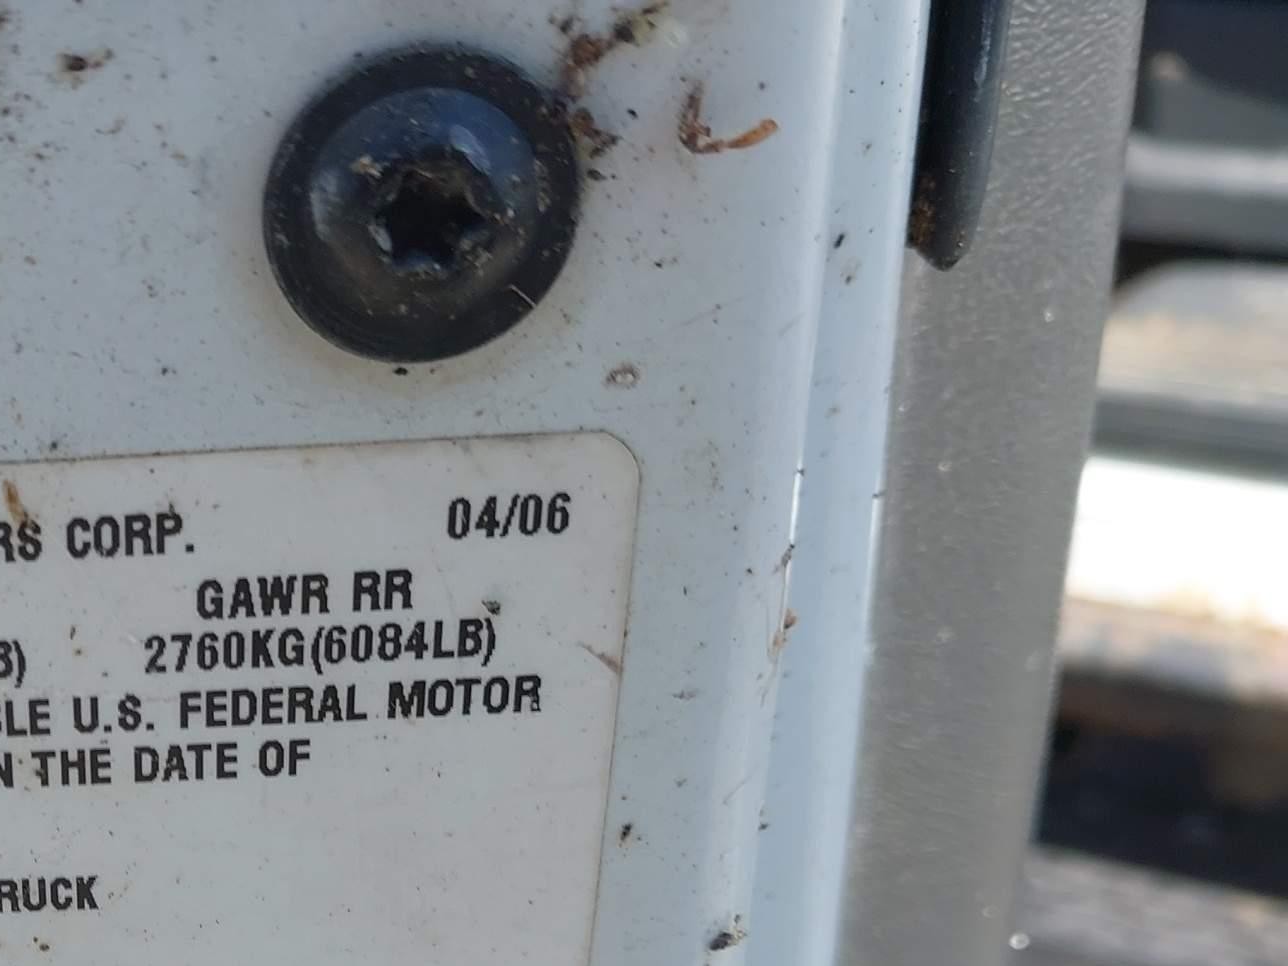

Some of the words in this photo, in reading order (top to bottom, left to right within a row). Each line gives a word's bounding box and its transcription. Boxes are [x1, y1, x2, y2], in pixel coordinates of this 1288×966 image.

[66, 506, 194, 559] CORP.
[447, 492, 571, 539] 04/06
[197, 573, 330, 620] GAWR
[353, 569, 413, 612] RR
[145, 617, 496, 675] 2760KG(6084LB)
[73, 693, 154, 733] U.S.
[180, 684, 367, 728] FEDERAL
[387, 675, 541, 719] MOTOR
[31, 748, 111, 786] THE
[134, 742, 237, 782] DATE
[259, 739, 310, 776] OF
